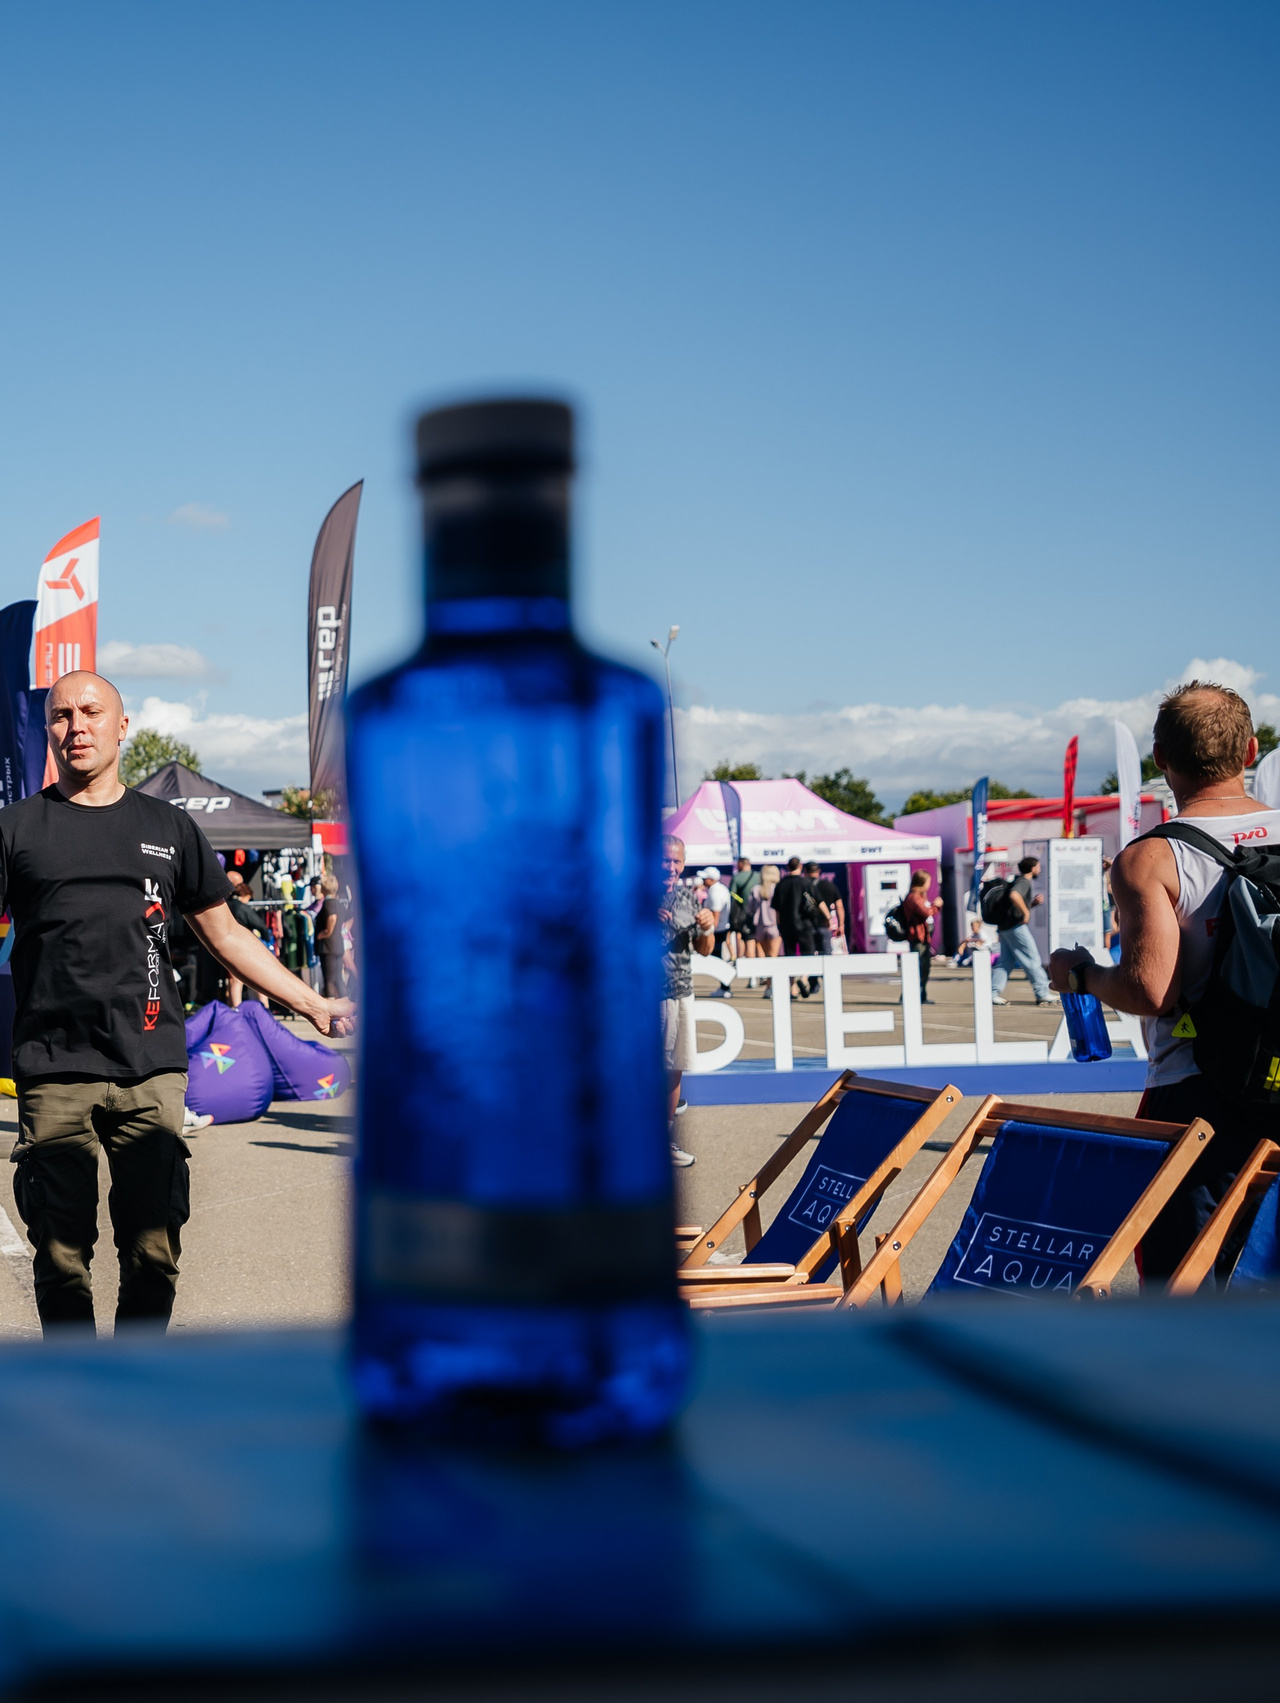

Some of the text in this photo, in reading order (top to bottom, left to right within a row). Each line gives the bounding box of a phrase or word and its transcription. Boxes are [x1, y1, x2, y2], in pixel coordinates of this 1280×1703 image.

[141, 848, 172, 860] WELLNESS
[989, 1226, 1094, 1260] STELLAR
[974, 1254, 1073, 1295] AQUA
